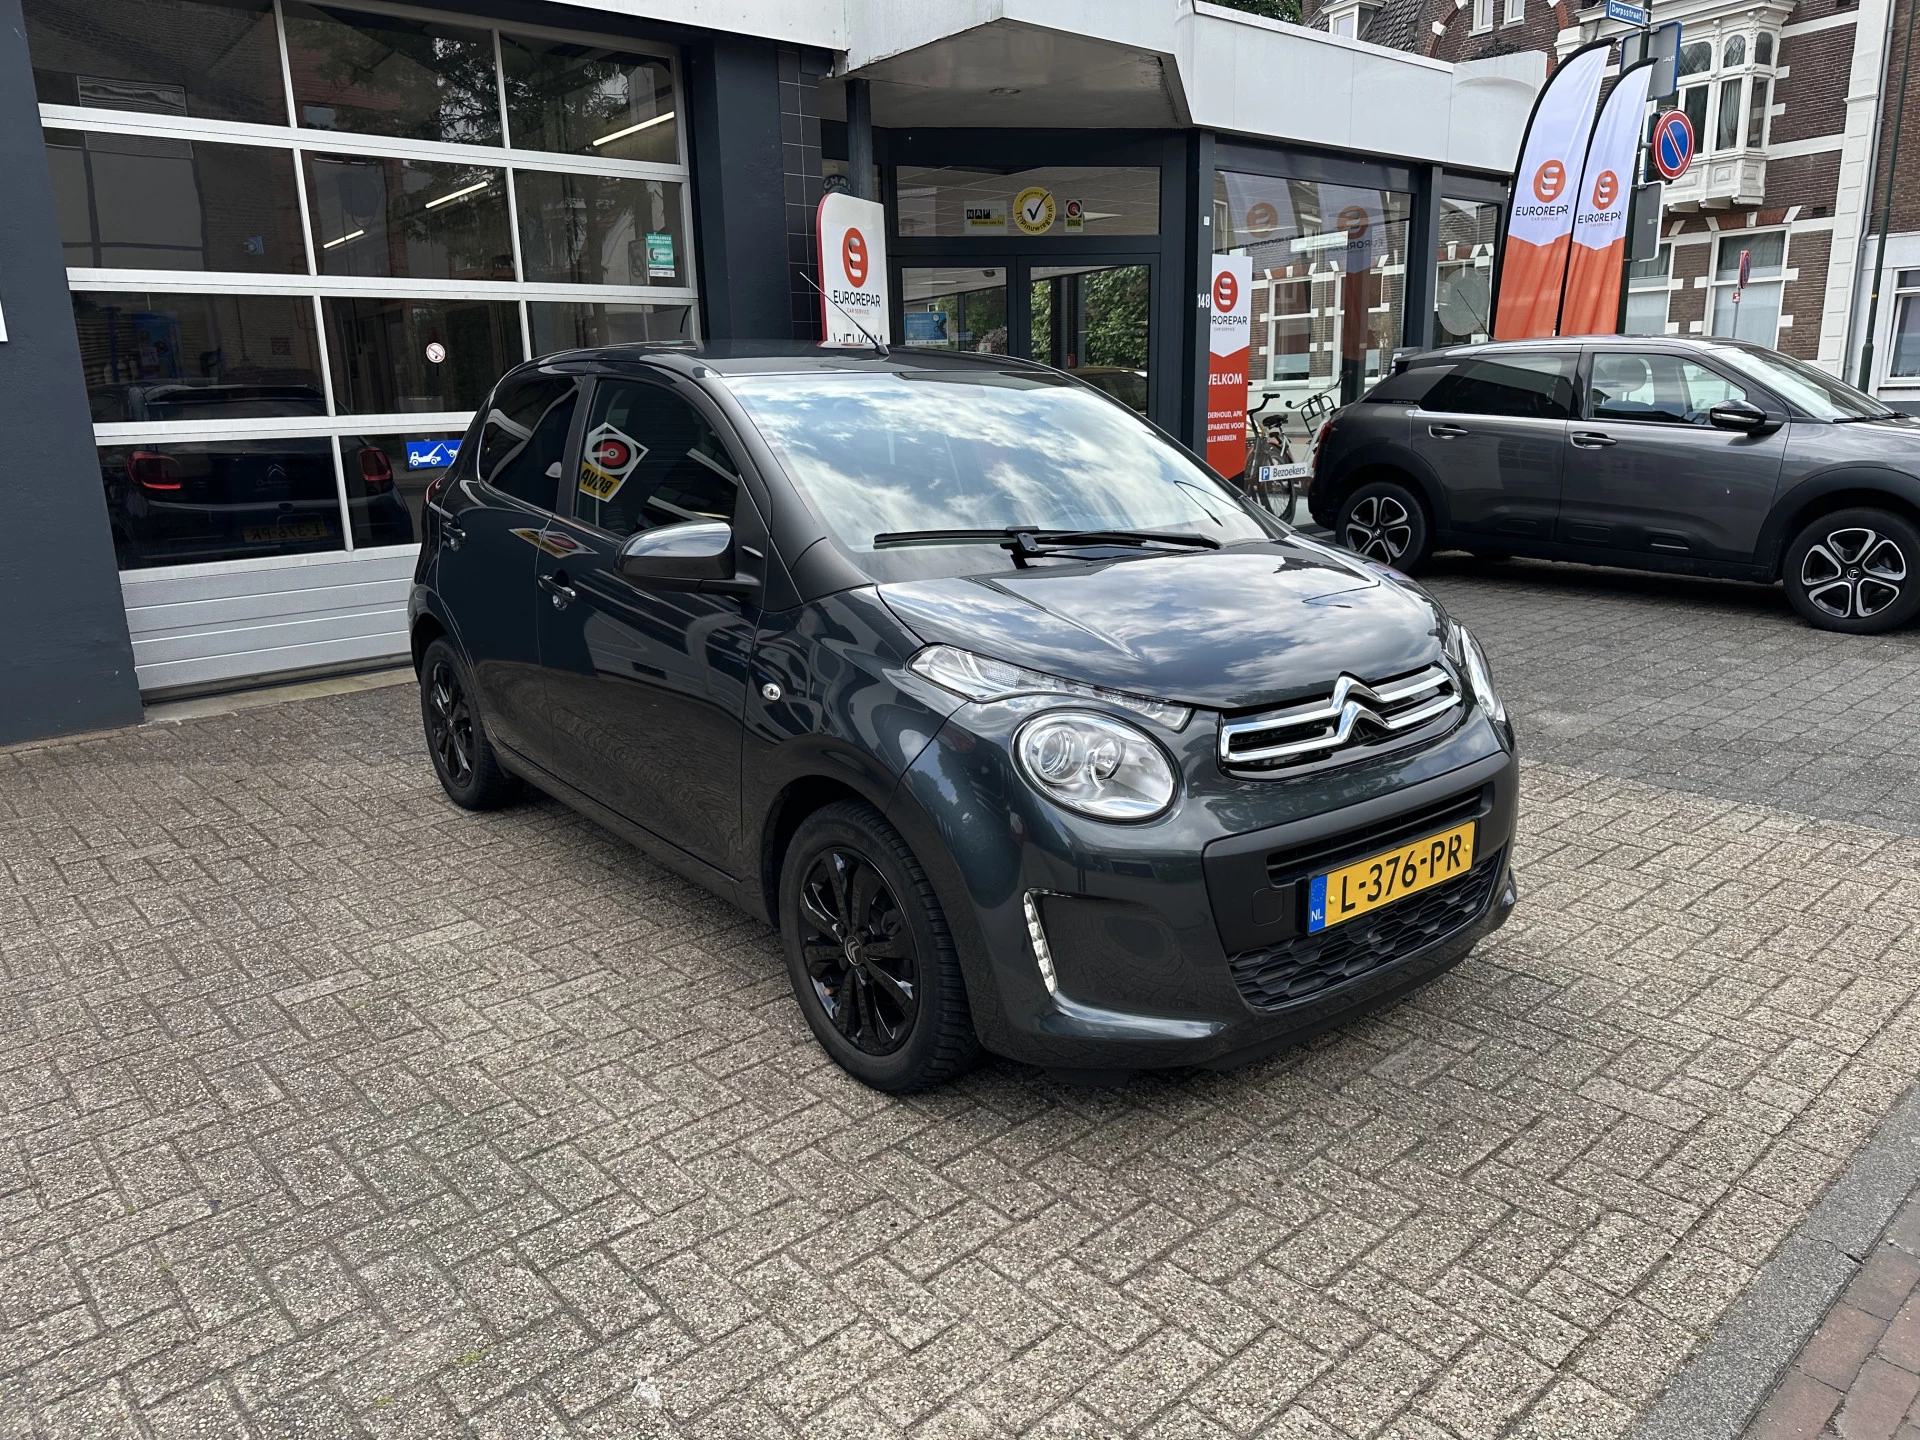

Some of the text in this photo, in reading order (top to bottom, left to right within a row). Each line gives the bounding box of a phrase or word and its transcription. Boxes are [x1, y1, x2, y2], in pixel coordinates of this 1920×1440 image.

[1611, 3, 1642, 21] Dorpsstraat
[967, 208, 991, 219] NAP
[1515, 204, 1569, 216] EUROREPR
[833, 289, 881, 308] EUROREPAR
[1197, 293, 1211, 308] 148
[1210, 315, 1248, 325] ROREPAR
[1230, 421, 1245, 429] VOOR
[1217, 434, 1237, 442] MERKEN
[1272, 465, 1306, 478] Bezoekers
[1311, 834, 1462, 923] NL L-376-PR
